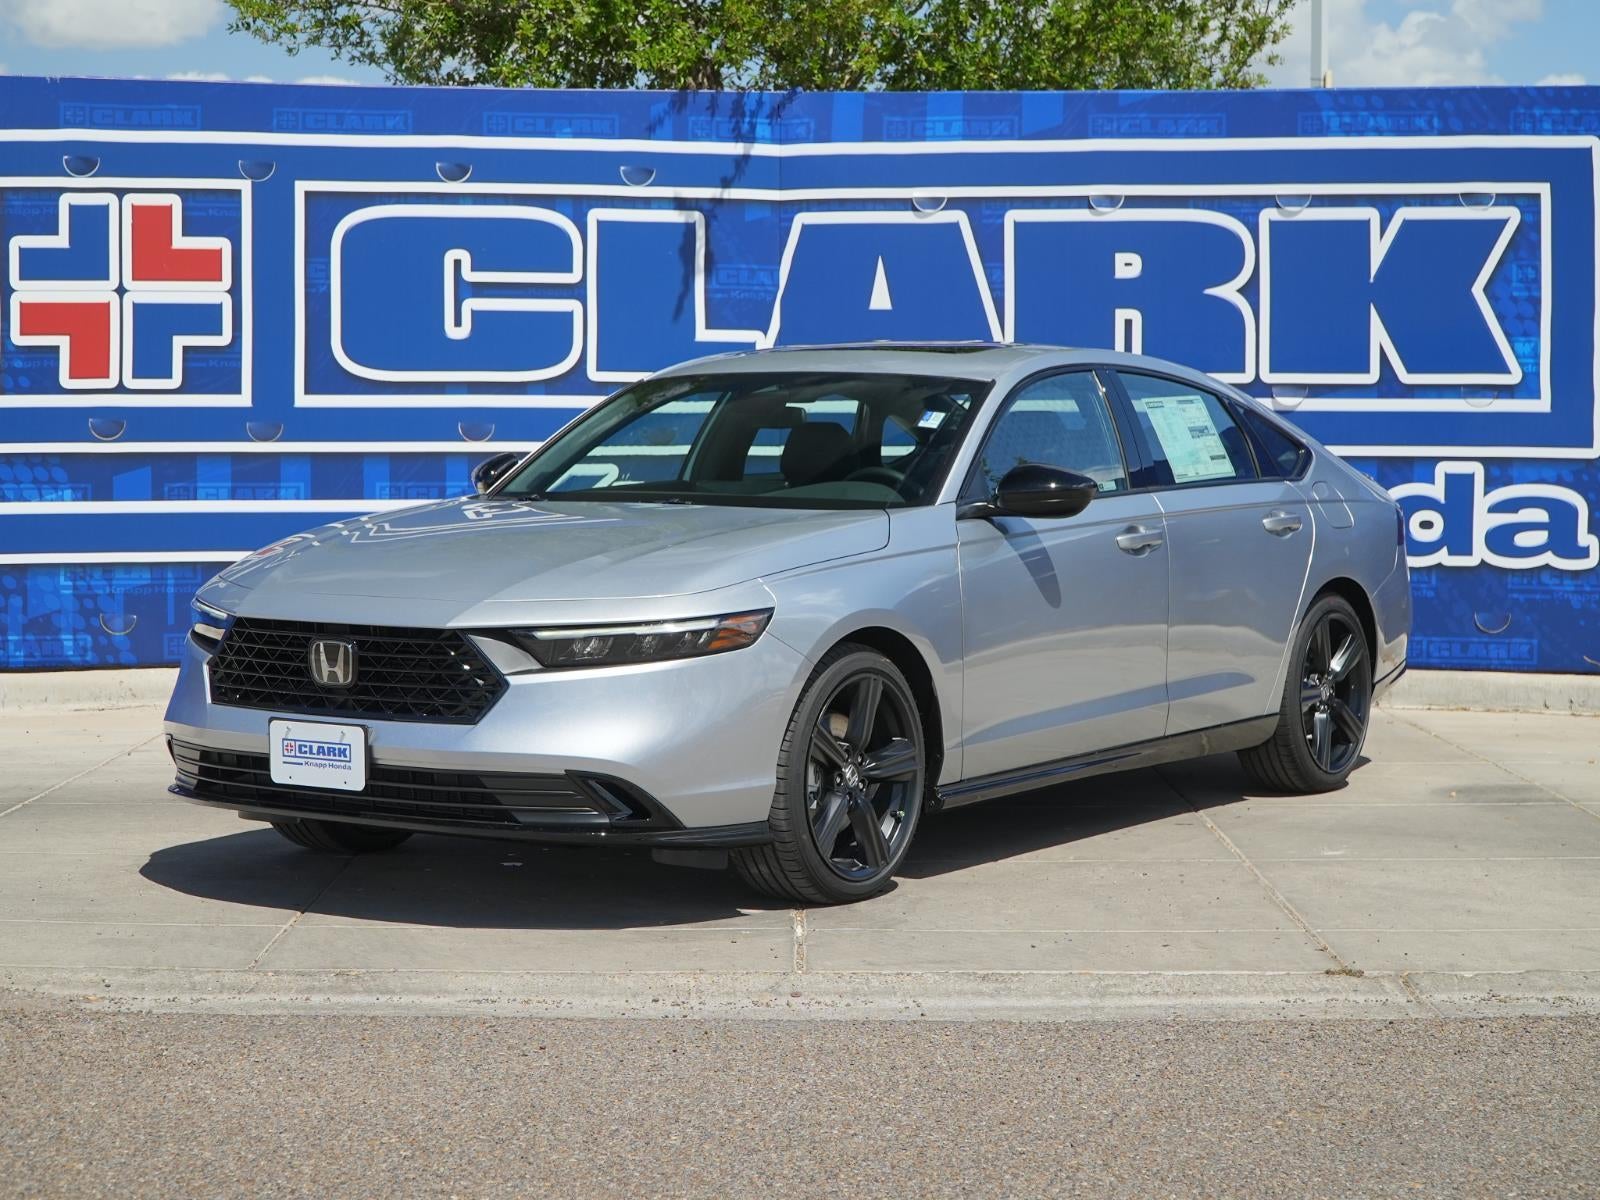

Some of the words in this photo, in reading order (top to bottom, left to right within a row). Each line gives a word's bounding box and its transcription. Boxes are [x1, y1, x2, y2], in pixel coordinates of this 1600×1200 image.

[330, 203, 1522, 386] CLARK
[297, 743, 348, 758] CLARK
[304, 760, 327, 769] Knapp
[328, 762, 352, 771] Honda
